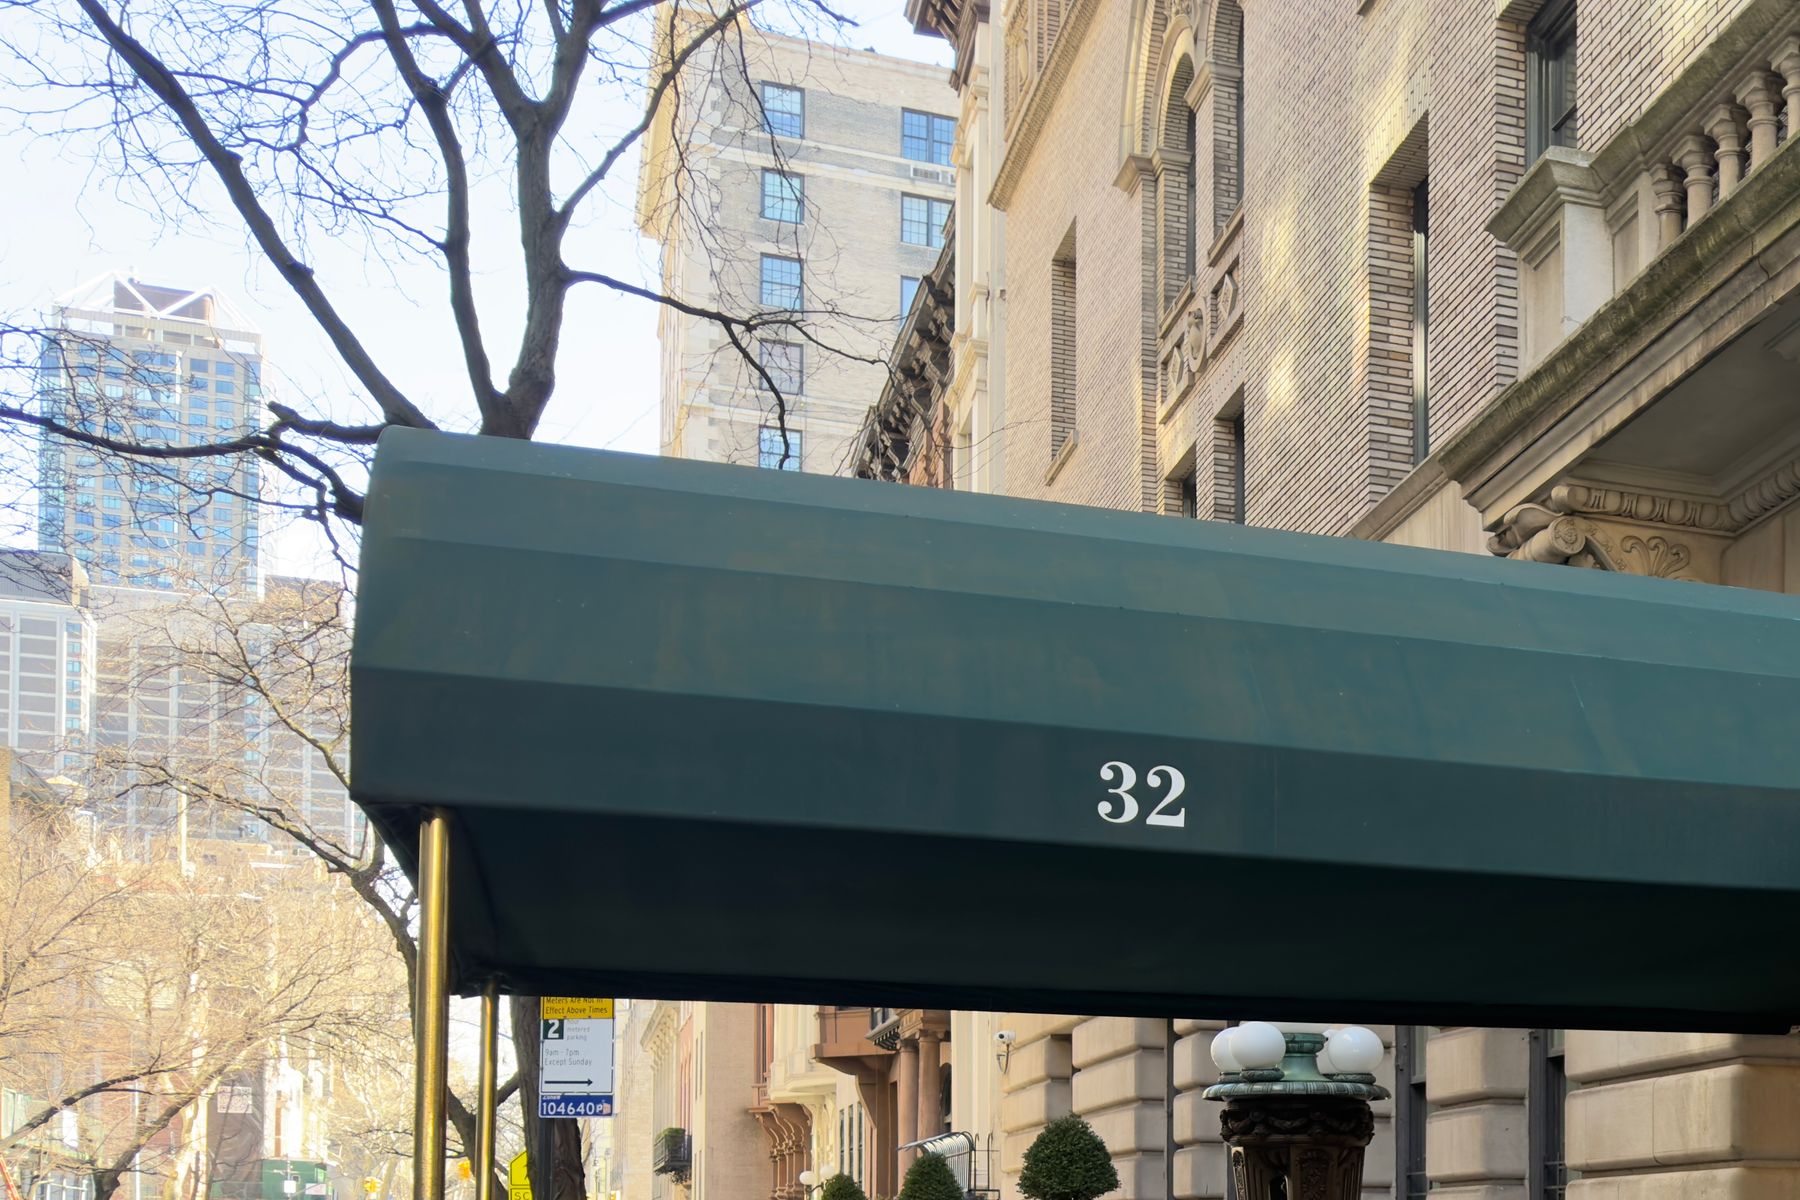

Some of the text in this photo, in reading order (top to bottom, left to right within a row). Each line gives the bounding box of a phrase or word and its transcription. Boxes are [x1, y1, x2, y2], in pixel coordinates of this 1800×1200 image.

[1097, 761, 1186, 828] 32
[567, 1006, 588, 1014] Above
[589, 1006, 608, 1014] Times
[547, 1019, 560, 1038] 2
[545, 1057, 592, 1066] Except Sunday
[542, 1102, 595, 1115] 104640
